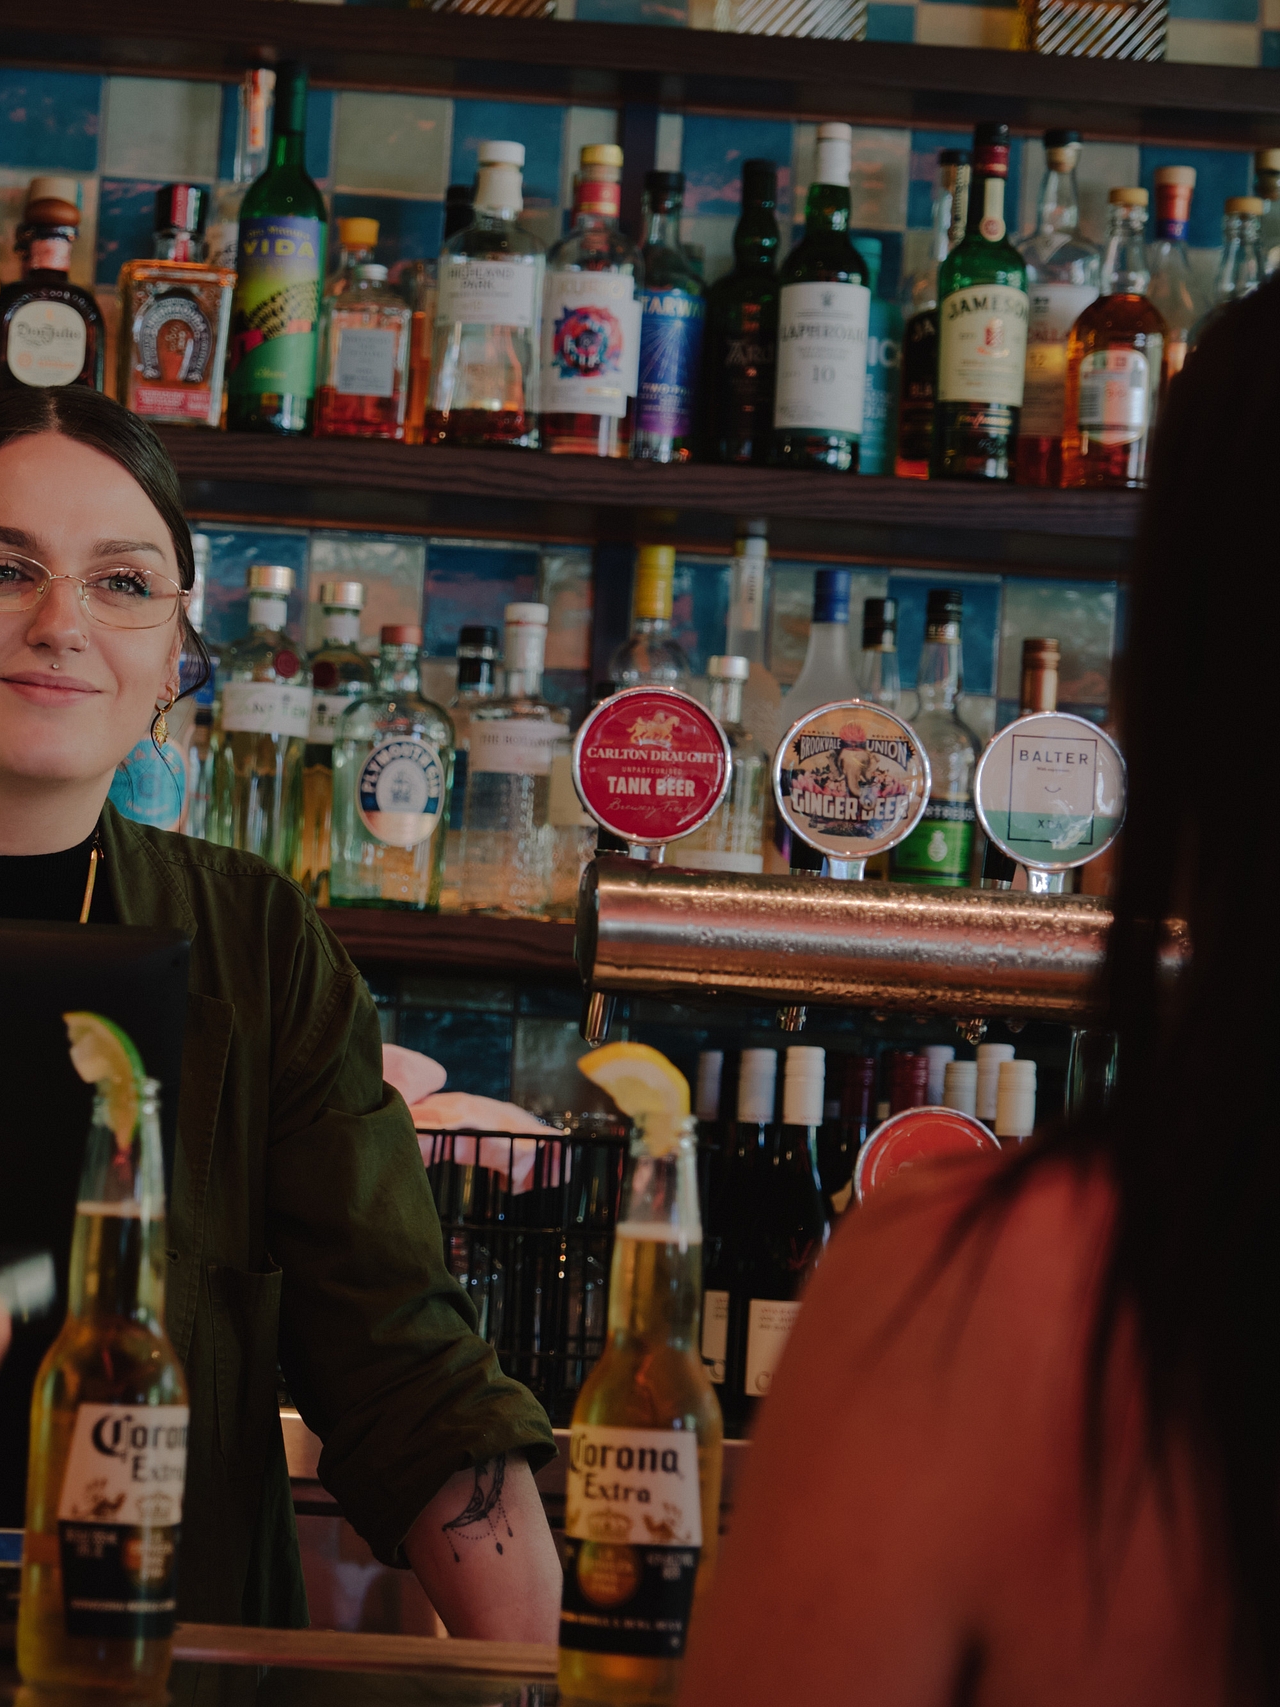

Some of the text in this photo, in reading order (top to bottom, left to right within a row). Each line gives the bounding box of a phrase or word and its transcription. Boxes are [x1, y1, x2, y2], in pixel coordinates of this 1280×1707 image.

[242, 238, 315, 258] VIDA
[813, 364, 835, 384] 10
[586, 747, 716, 764] CARLTON DRAUGHT
[800, 735, 908, 767] BROOKVALE UNION
[1020, 750, 1089, 765] BALTER
[361, 743, 440, 798] PLYMOUTH GIN
[621, 766, 683, 775] UNPASTEURISED
[607, 776, 696, 797] TANK BEER
[606, 798, 657, 819] Brewery
[791, 787, 858, 820] GINGER
[569, 1433, 685, 1475] Corona
[584, 1472, 652, 1504] Extra
